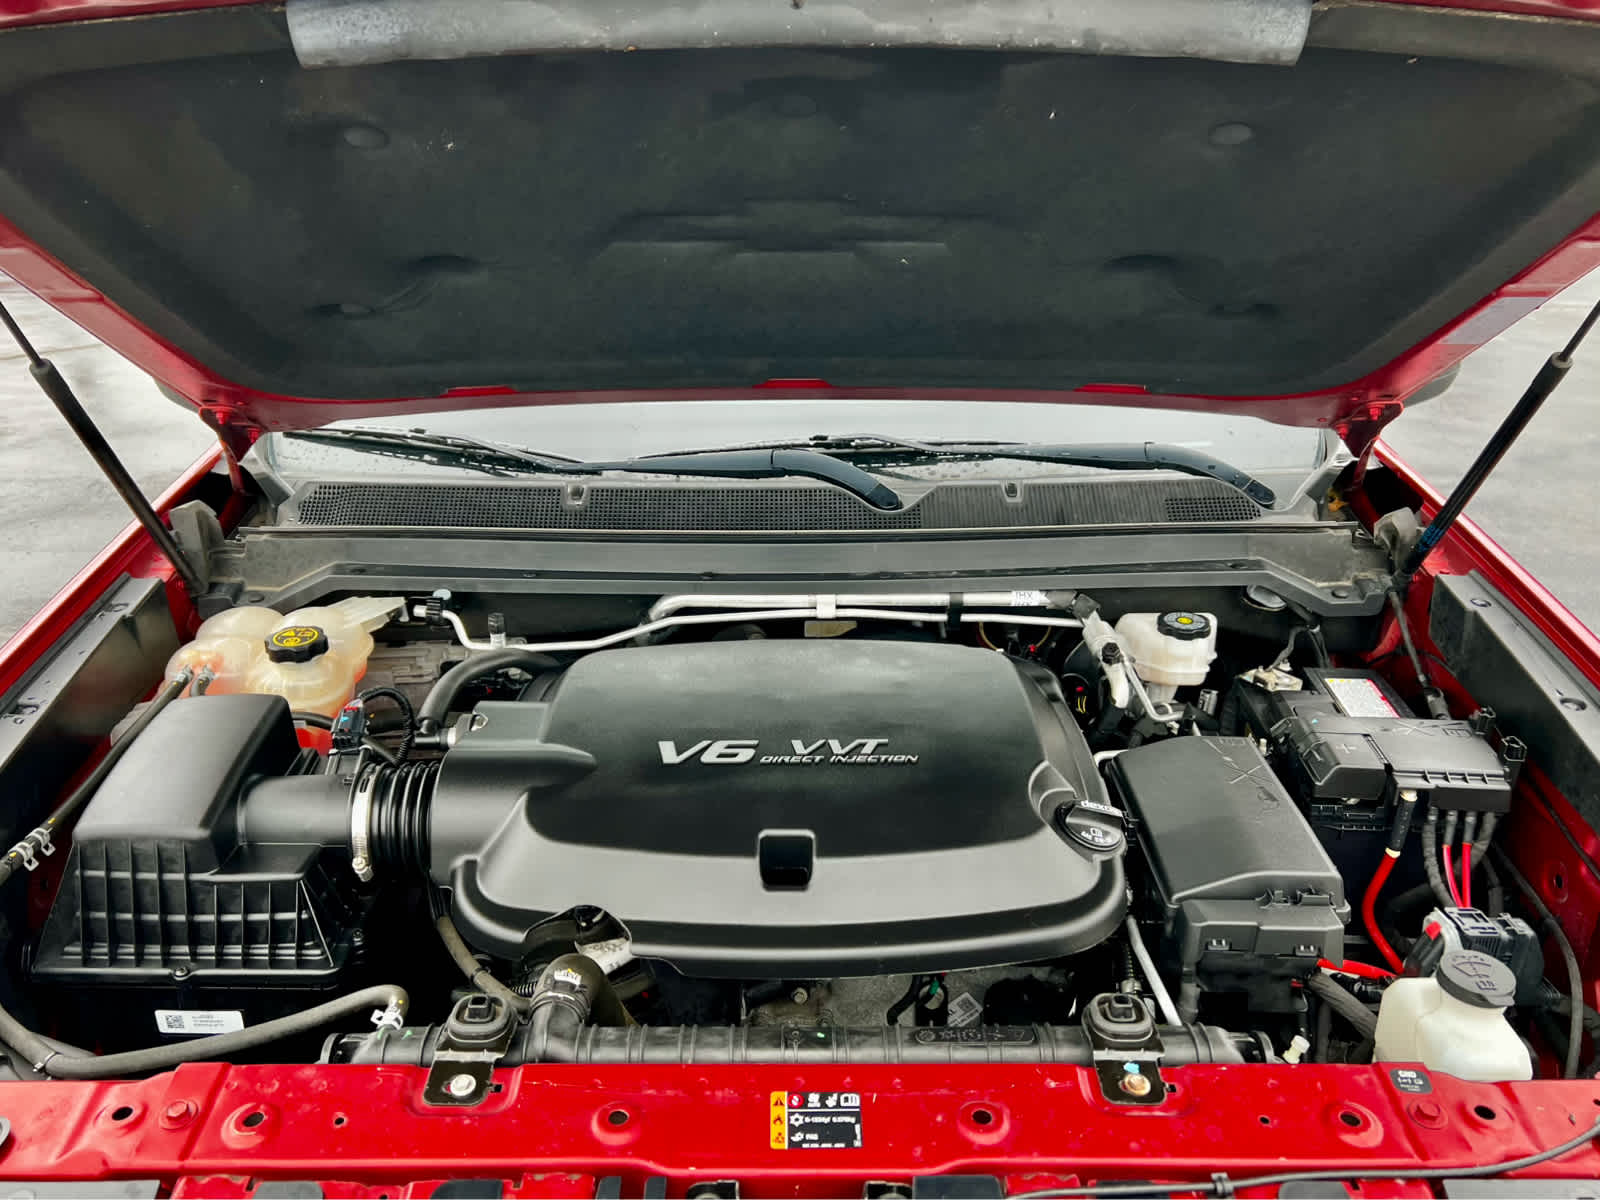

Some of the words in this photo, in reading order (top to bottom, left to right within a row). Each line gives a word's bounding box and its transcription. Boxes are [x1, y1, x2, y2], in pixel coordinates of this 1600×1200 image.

[658, 739, 760, 765] V6
[791, 738, 889, 756] VVT
[759, 754, 825, 764] DIRECT
[829, 754, 919, 764] INJECTION
